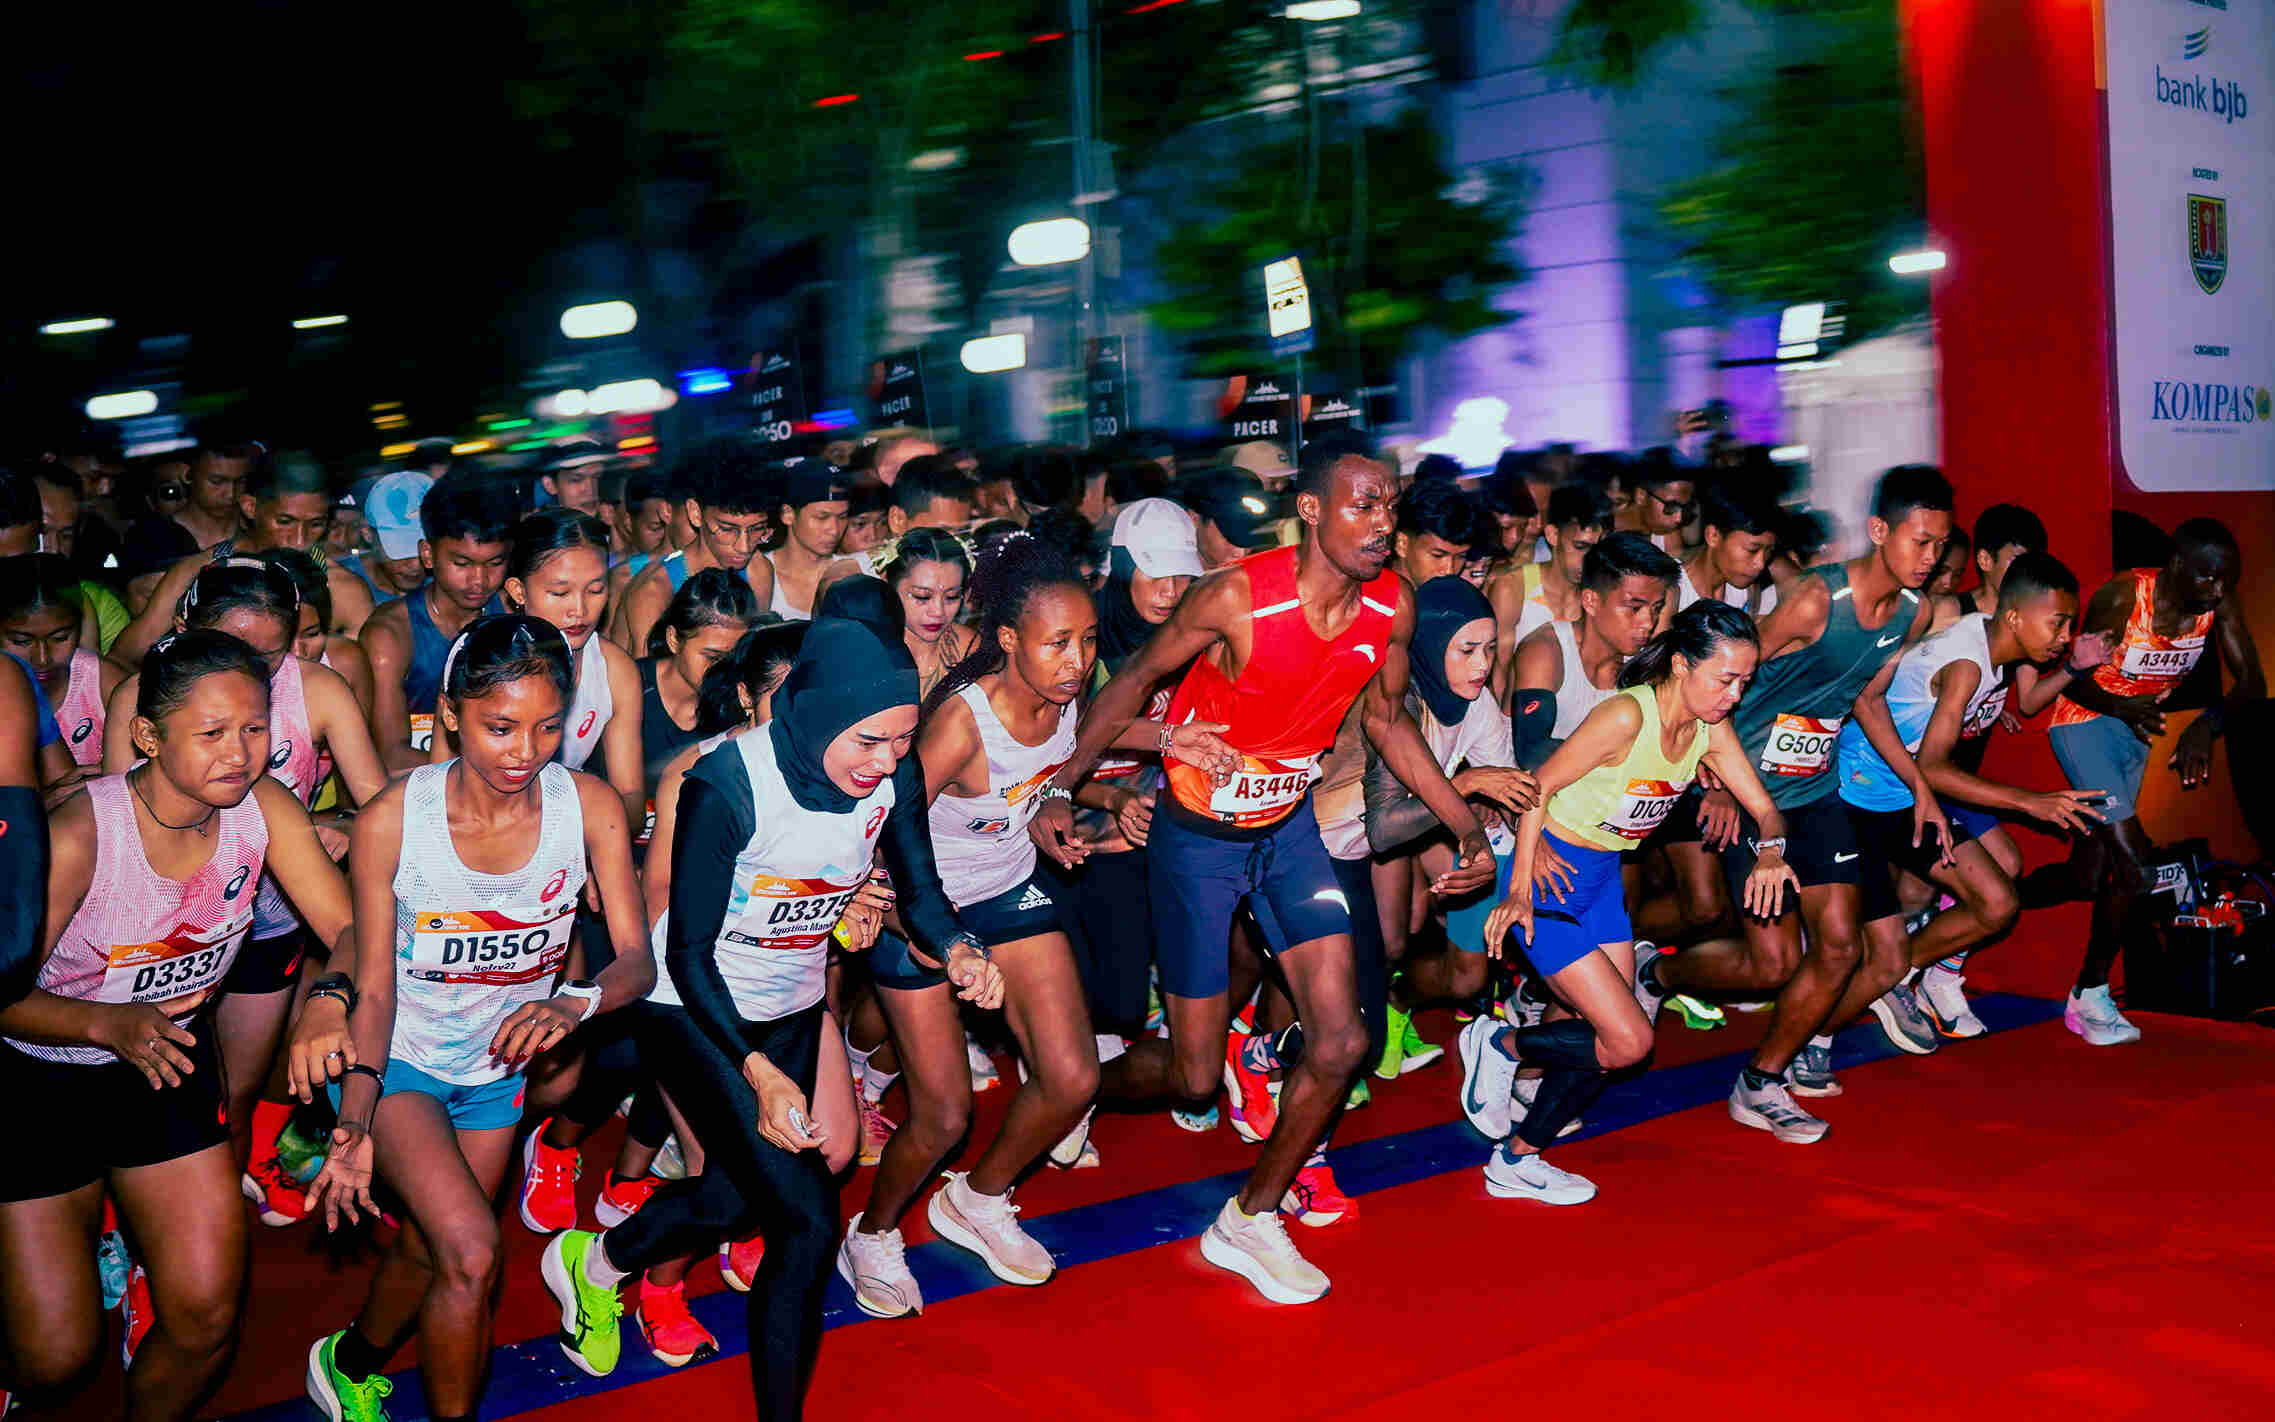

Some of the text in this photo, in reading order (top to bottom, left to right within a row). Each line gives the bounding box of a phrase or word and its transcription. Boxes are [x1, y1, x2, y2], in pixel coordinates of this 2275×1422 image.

[2156, 63, 2247, 124] bank bjb
[2151, 382, 2255, 423] KOMPAS
[1234, 419, 1278, 436] PACER
[2139, 652, 2190, 666] A3443
[1234, 772, 1310, 799] A3446
[1018, 897, 1053, 911] adidas
[441, 929, 550, 965] D1550
[132, 943, 229, 993] D3337
